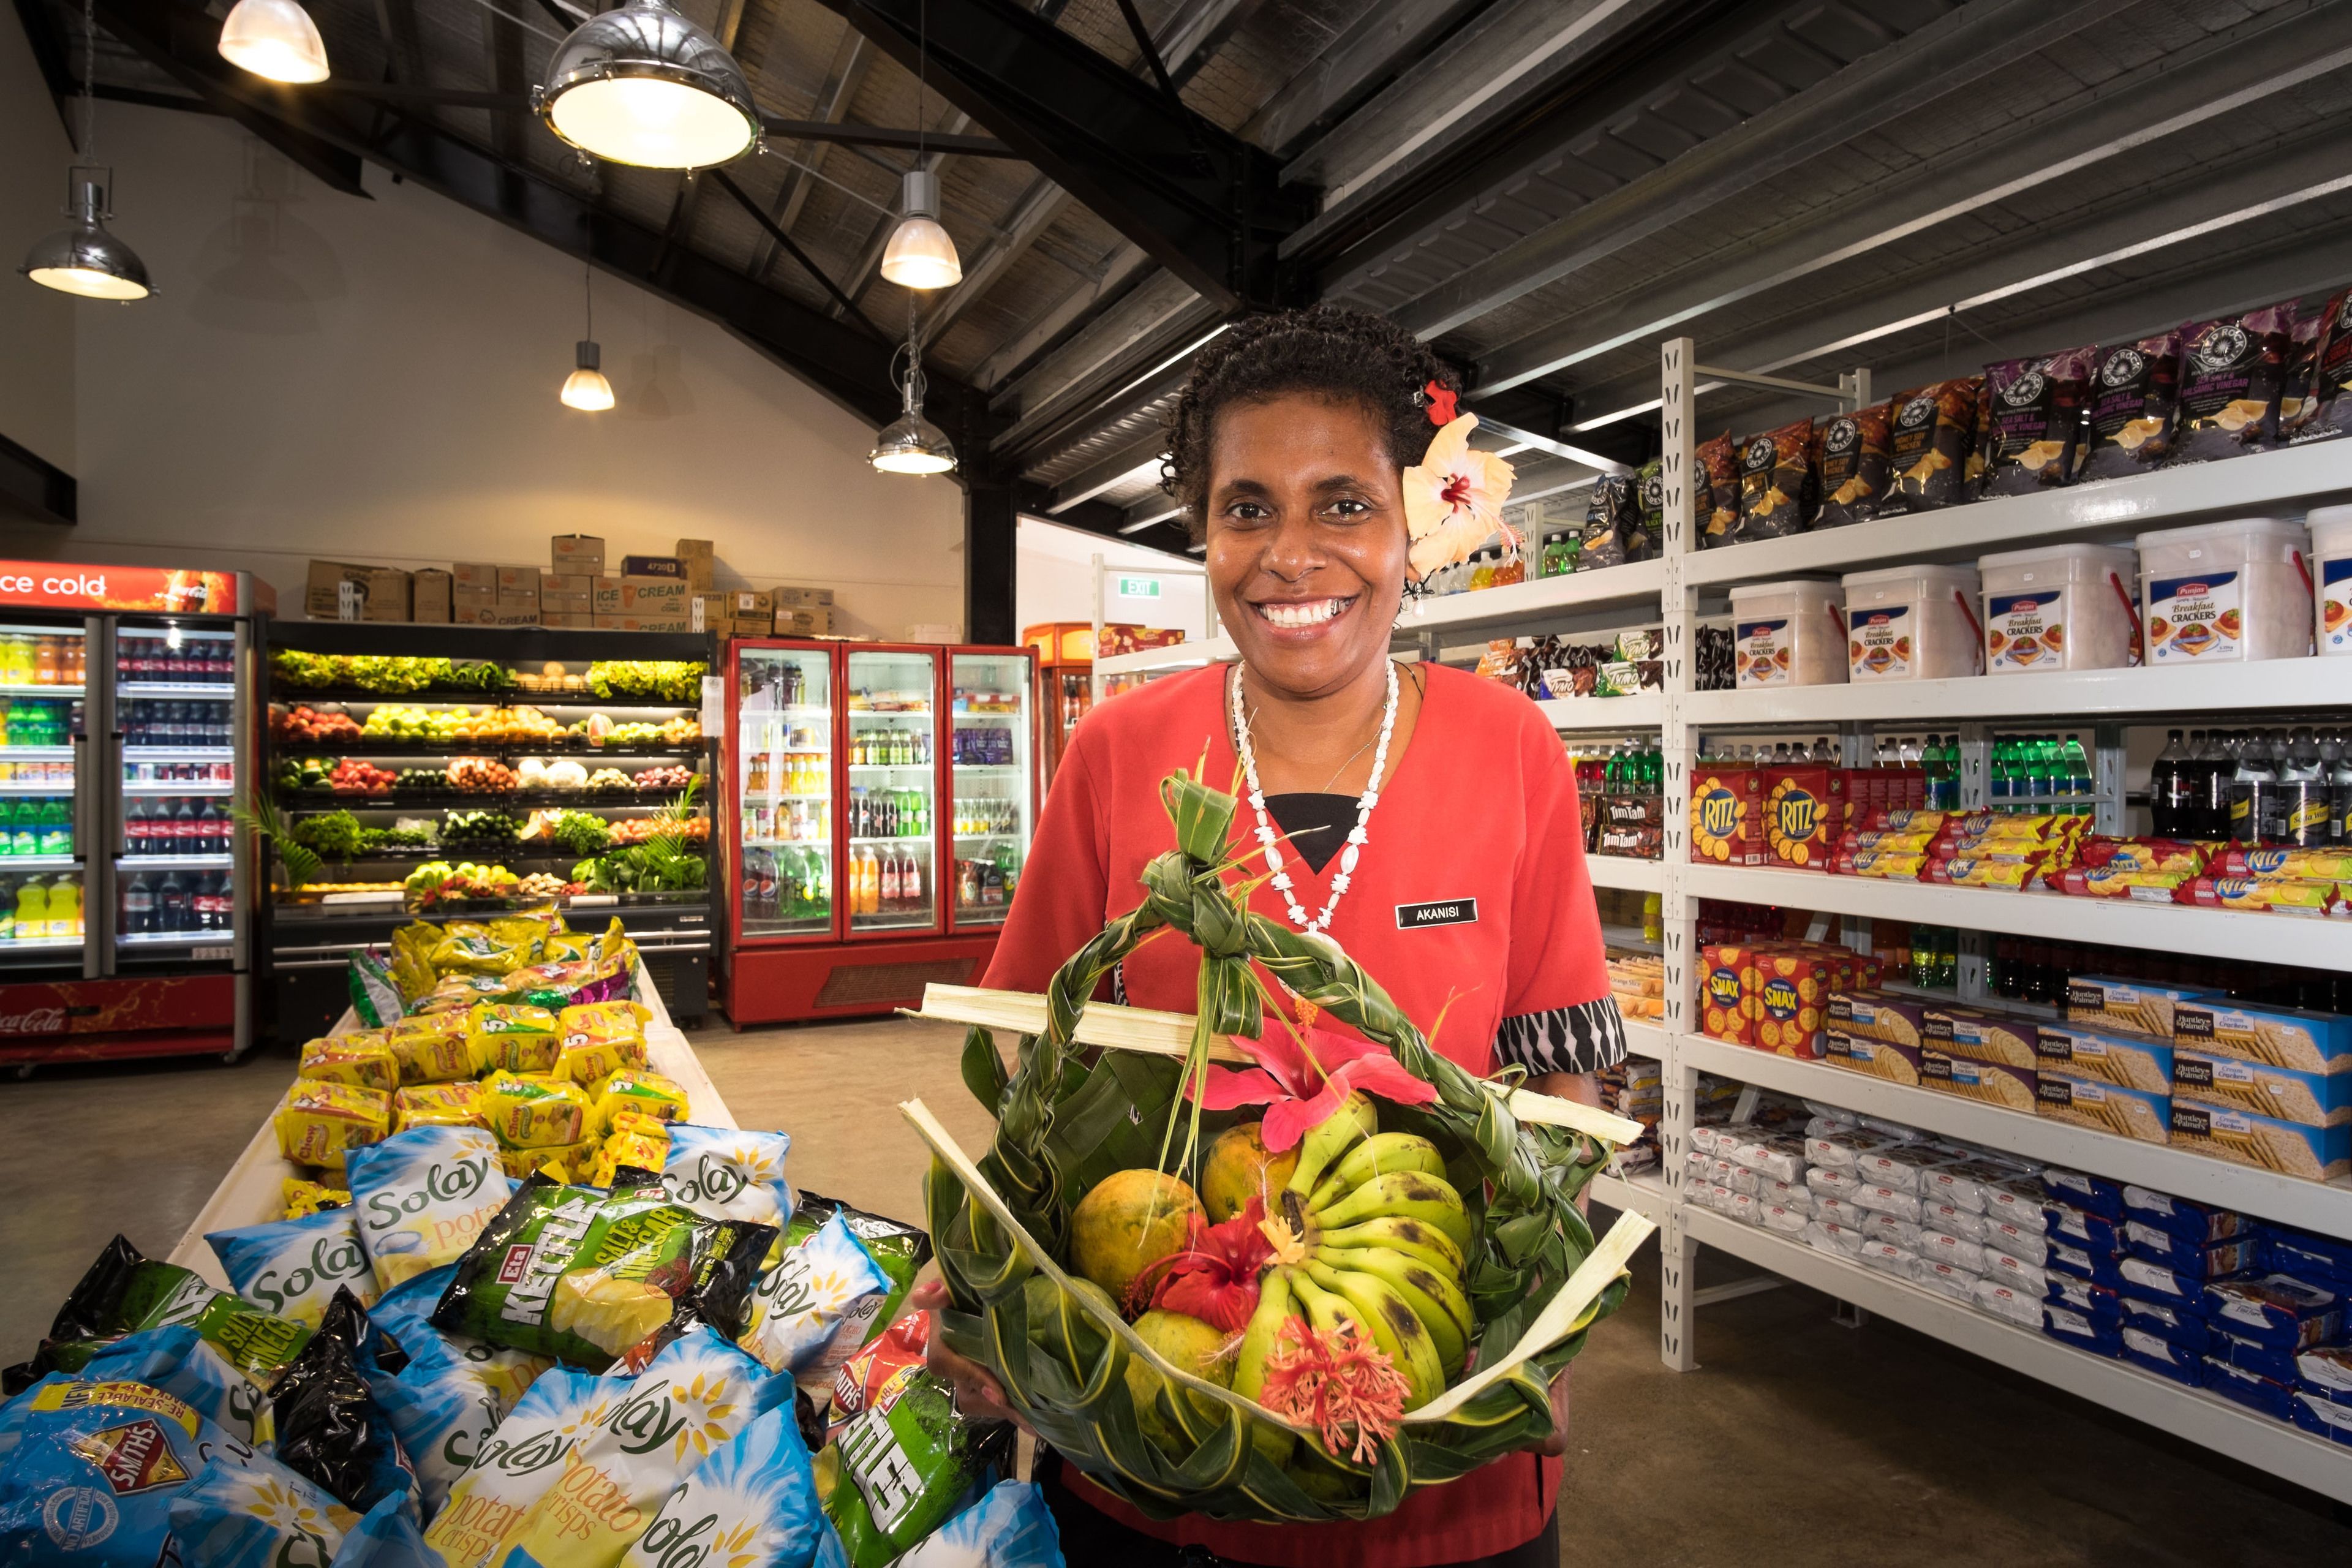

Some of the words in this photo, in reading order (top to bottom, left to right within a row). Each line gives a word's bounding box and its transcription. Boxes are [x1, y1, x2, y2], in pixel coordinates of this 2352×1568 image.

[2222, 328, 2245, 349] ROCK
[2120, 352, 2141, 371] ROCK
[2207, 353, 2236, 364] DELI
[2024, 374, 2041, 390] ROCK
[2216, 378, 2248, 390] VINEGAR
[2009, 393, 2033, 404] DELI
[1904, 414, 1923, 425] DELI
[647, 563, 667, 571] 4720
[0, 575, 34, 593] ce
[42, 574, 107, 595] cold
[1128, 581, 1152, 594] EXIT
[2180, 586, 2206, 596] Punjas
[597, 589, 619, 601] ICE
[637, 584, 685, 598] CREAM
[2172, 600, 2215, 614] Breakfast
[499, 614, 538, 625] CREAM
[2007, 616, 2042, 628] Breakfast
[2171, 611, 2216, 624] CRACKERS
[639, 622, 687, 633] CREAM
[2007, 625, 2043, 636] CRACKERS
[1864, 637, 1894, 647] CRACKERS
[1550, 678, 1574, 693] TYMO
[1610, 673, 1638, 687] TYMO
[1705, 797, 1735, 832] RITZ
[1781, 798, 1813, 835] RITZ
[1417, 906, 1458, 921] AKANISI
[1711, 976, 1740, 999] SNAX
[1771, 982, 1790, 992] ORIGINAL
[1765, 987, 1797, 1011] SNAX
[2073, 990, 2097, 1000] Huntley
[2179, 1015, 2206, 1025] Huntley
[2219, 1021, 2248, 1030] Crackers
[2041, 1039, 2065, 1049] Huntley
[2177, 1064, 2205, 1074] Huntley
[2218, 1071, 2247, 1080] Crackers
[2041, 1083, 2065, 1094] Huntley
[507, 1107, 521, 1139] Chow
[2176, 1112, 2203, 1124] Huntley
[2215, 1121, 2245, 1131] Crackers
[299, 1125, 316, 1159] Chow
[369, 1157, 489, 1231] Solay
[595, 1218, 630, 1267] SALT
[628, 1221, 643, 1234] &
[501, 1196, 608, 1326] KETTLE
[503, 1250, 529, 1278] Eta
[843, 1298, 883, 1325] olay
[61, 1382, 96, 1408] NEW
[97, 1391, 184, 1419] RE-SEALABLE
[598, 1379, 687, 1455] olay
[110, 1425, 157, 1488] SMITH'S
[473, 1429, 576, 1477] olay
[62, 1533, 80, 1552] NO
[72, 1486, 93, 1532] ARTIFICIAL
[429, 1494, 527, 1543] potat
[546, 1491, 597, 1542] crisps
